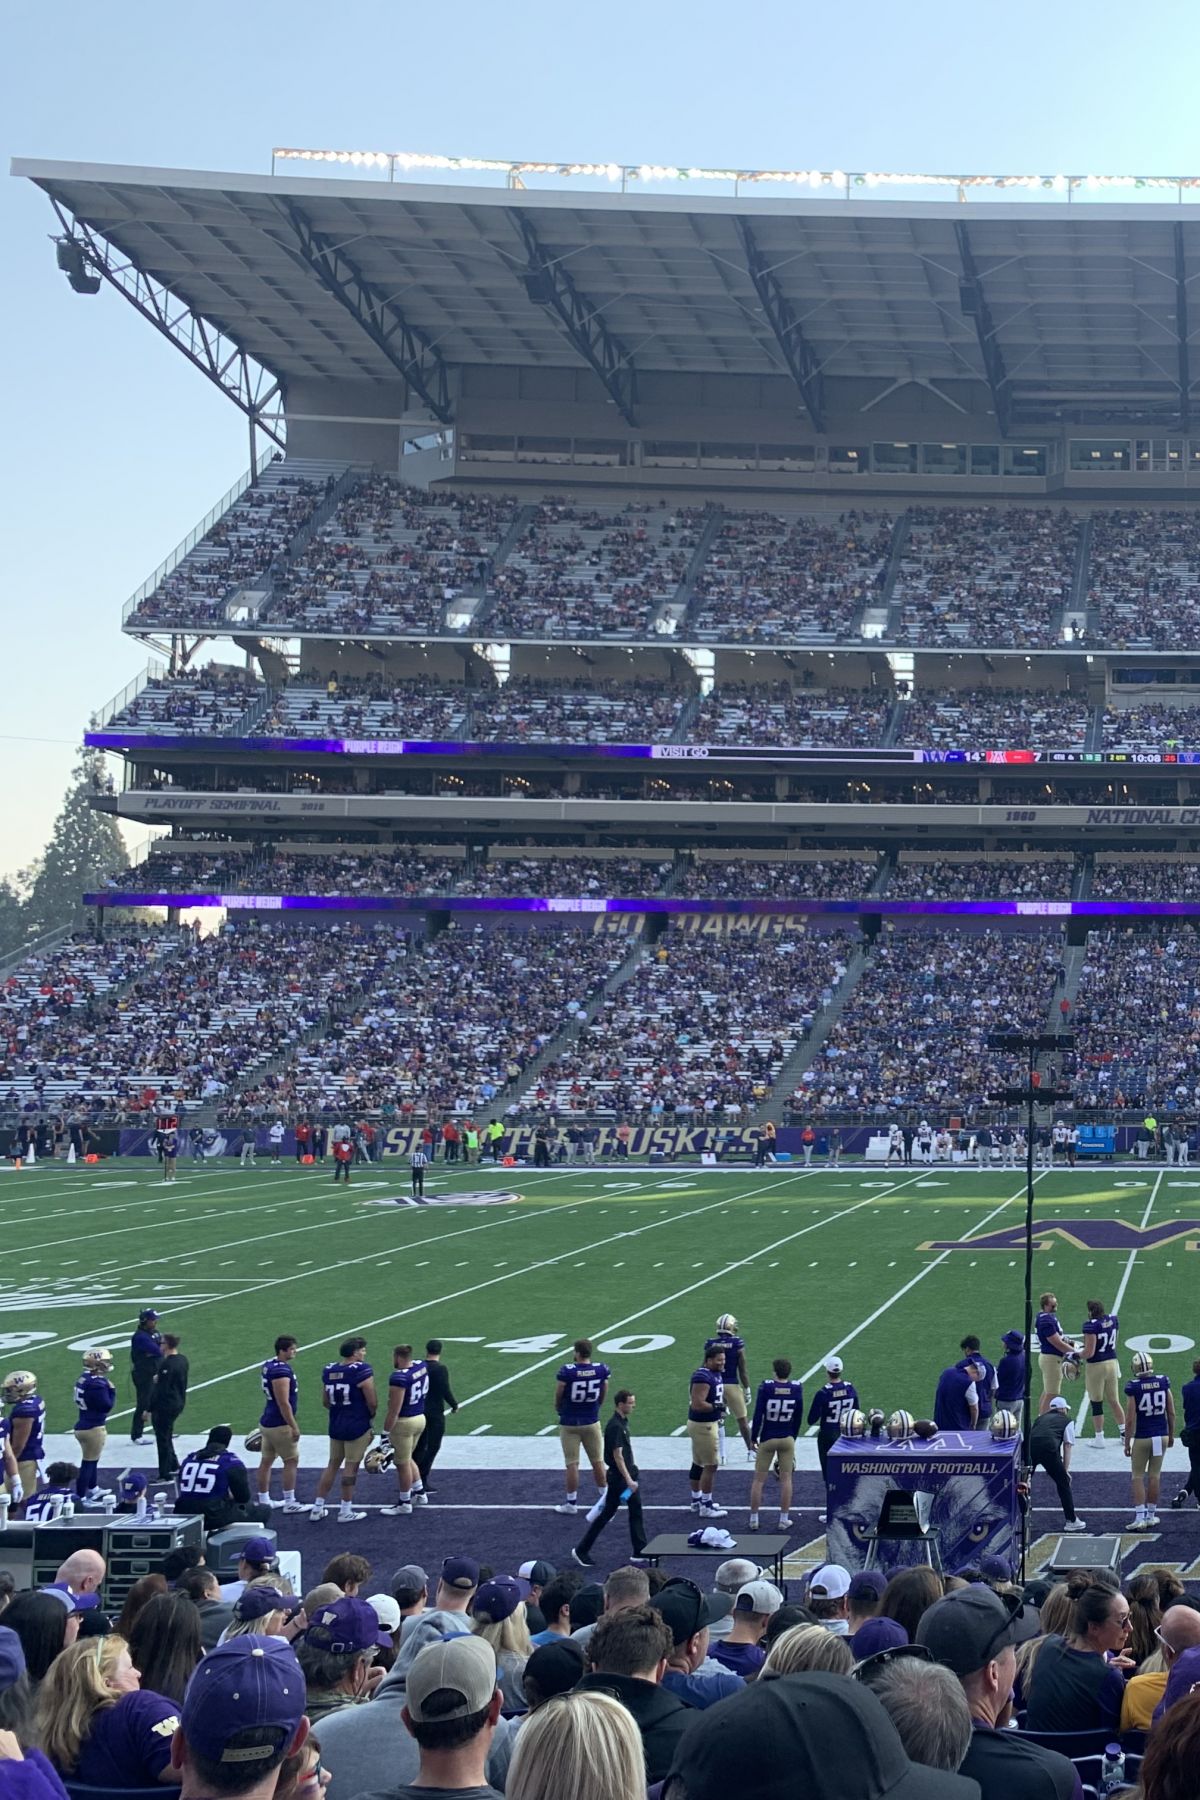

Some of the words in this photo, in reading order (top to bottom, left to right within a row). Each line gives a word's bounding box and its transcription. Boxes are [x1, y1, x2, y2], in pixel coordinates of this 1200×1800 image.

[343, 741, 376, 753] PURPLE
[662, 748, 689, 758] VISIT
[964, 752, 981, 762] 14
[1033, 752, 1041, 762] 7
[1131, 753, 1161, 763] 10:08
[144, 798, 206, 810] PLAYOFF
[210, 800, 281, 812] SEMIFINAL
[1086, 809, 1174, 824] NATIONAL
[594, 912, 646, 935] GO
[1097, 1328, 1118, 1353] 74
[325, 1383, 352, 1406] 77
[409, 1375, 429, 1405] 64
[570, 1380, 601, 1403] 65
[765, 1399, 796, 1423] 85
[1138, 1390, 1167, 1417] 49
[841, 1461, 928, 1475] WASHINGTON
[929, 1461, 998, 1474] FOOTBALL
[180, 1462, 220, 1494] 95
